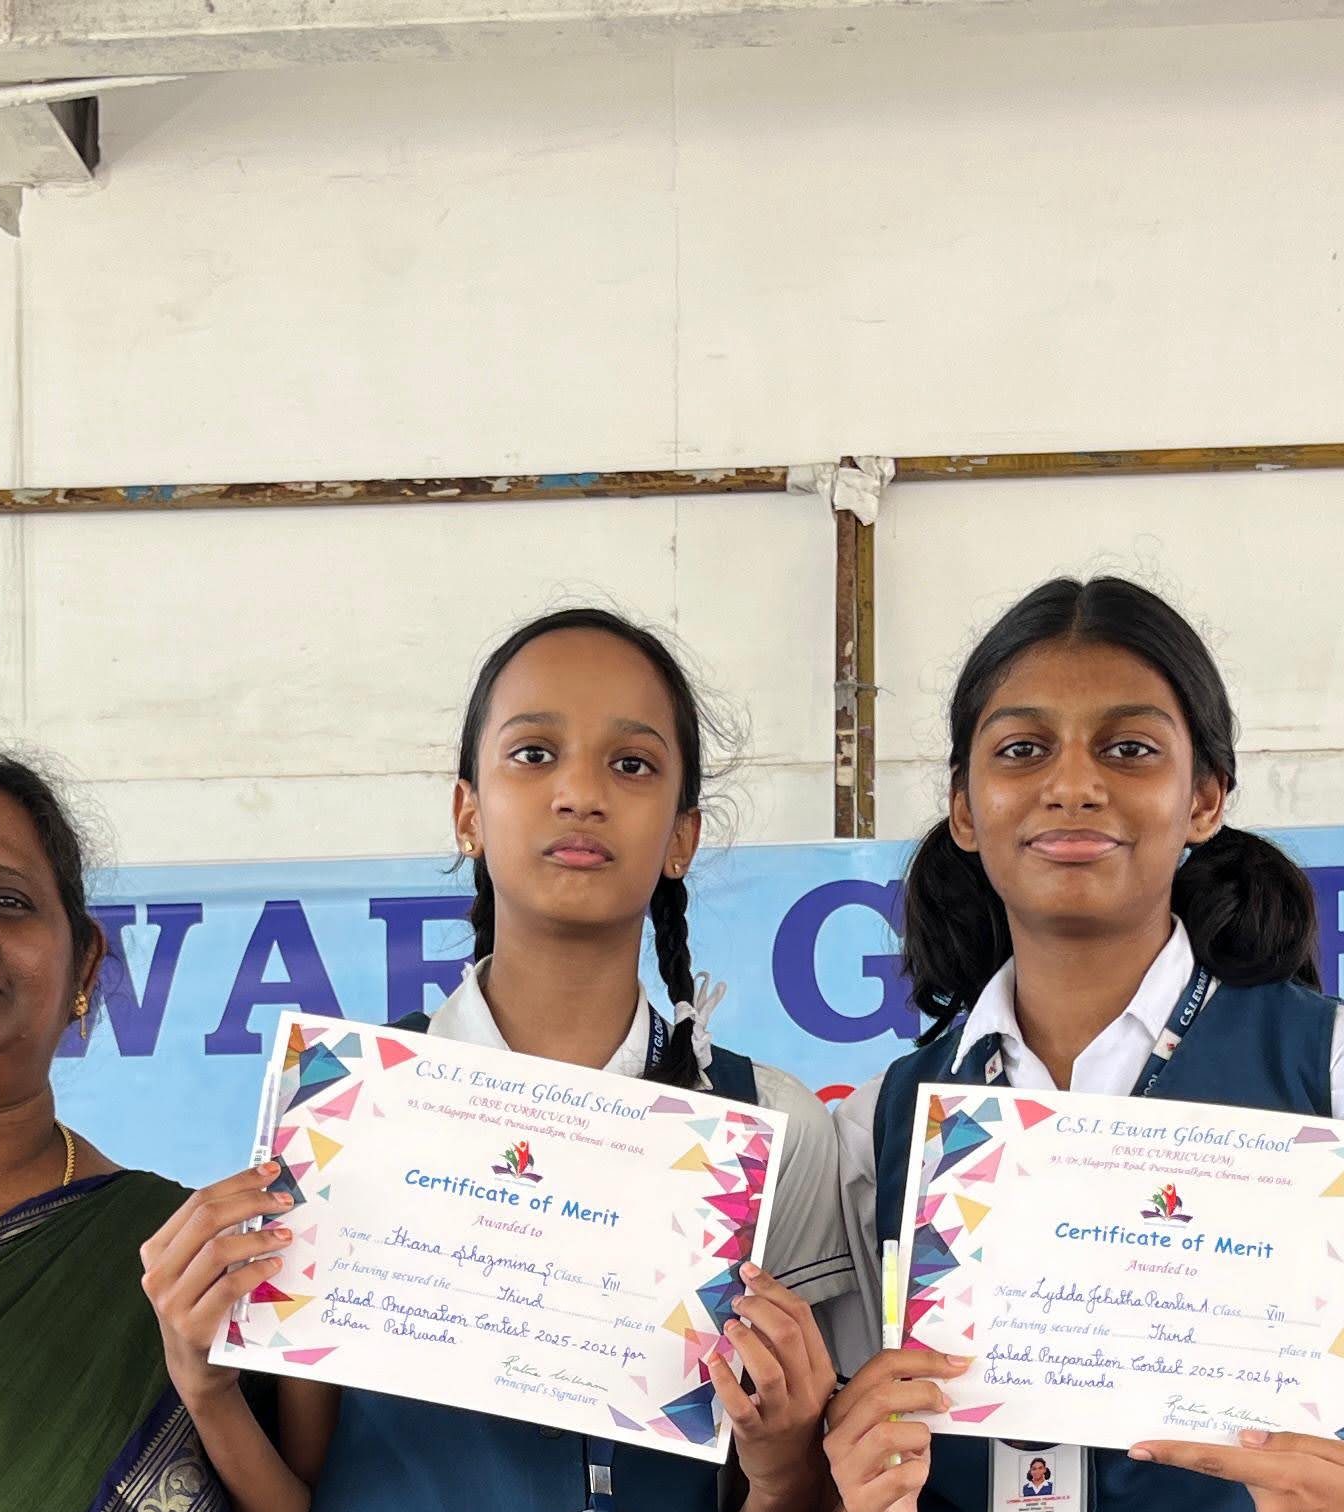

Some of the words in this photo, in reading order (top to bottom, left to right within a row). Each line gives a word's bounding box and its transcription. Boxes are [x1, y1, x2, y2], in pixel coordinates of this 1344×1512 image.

[416, 1060, 462, 1083] C.S.I.
[469, 1070, 526, 1095] Ewart
[532, 1083, 593, 1108] Global
[589, 1096, 651, 1121] School
[503, 1101, 591, 1130] CURRICULUM)
[1056, 1115, 1103, 1134] C.S.I.
[1109, 1120, 1168, 1140] Ewart
[1172, 1125, 1231, 1147] Global
[1233, 1132, 1295, 1153] School
[1147, 1147, 1235, 1167] CURRICULUM)
[405, 1169, 520, 1206] Certificate
[529, 1195, 553, 1213] of
[561, 1200, 619, 1227] Merit
[339, 1226, 372, 1242] Name
[472, 1215, 528, 1236] Awarded
[530, 1228, 544, 1238] to
[1055, 1222, 1172, 1248] Certificate
[1181, 1233, 1205, 1252] of
[1214, 1236, 1274, 1259] Merit
[328, 1257, 350, 1271] for
[352, 1260, 389, 1280] having
[391, 1271, 433, 1287] secured
[434, 1277, 451, 1290] the
[554, 1269, 583, 1284] Class
[1125, 1259, 1184, 1275] Awarded
[1185, 1266, 1198, 1277] to
[497, 1286, 544, 1309] Third
[994, 1285, 1027, 1299] Name
[381, 1295, 468, 1328] Preparation
[475, 1313, 530, 1338] Contest
[1212, 1304, 1241, 1317] Class
[613, 1315, 641, 1329] place
[645, 1323, 656, 1333] in
[988, 1315, 1008, 1330] for
[1010, 1316, 1048, 1334] having
[1050, 1321, 1090, 1335] secured
[1092, 1324, 1111, 1337] the
[1147, 1323, 1196, 1344] Third
[1038, 1346, 1124, 1374] Preparation
[1131, 1355, 1184, 1375] Contest
[1278, 1344, 1307, 1358] place
[1309, 1348, 1322, 1360] in
[494, 1374, 548, 1395] Principal's
[550, 1386, 599, 1406] Signature
[1162, 1414, 1217, 1431] Principal's
